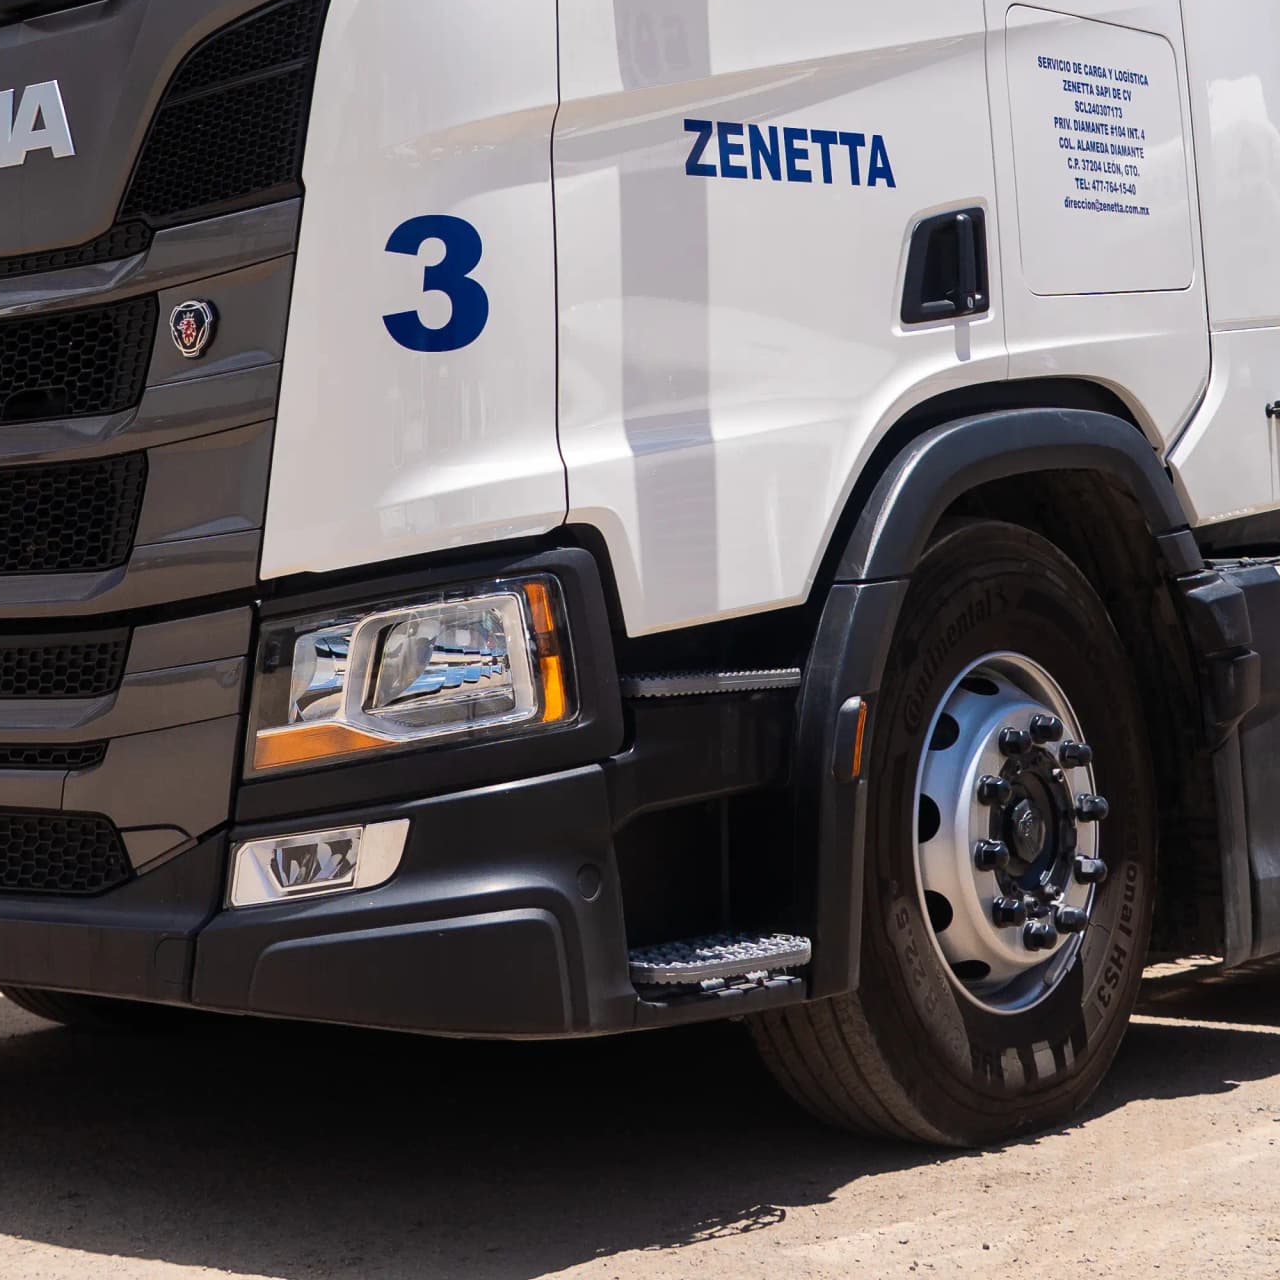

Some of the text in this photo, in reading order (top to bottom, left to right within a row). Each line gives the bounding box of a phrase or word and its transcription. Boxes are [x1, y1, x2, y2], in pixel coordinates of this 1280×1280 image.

[1037, 55, 1071, 73] SERVICIO
[1072, 62, 1082, 75] DE
[1083, 64, 1107, 79] CARGA
[1108, 68, 1113, 80] Y
[1062, 79, 1132, 102] ZENETTA SAPI DE CV
[1054, 116, 1072, 131] PRIV.
[1073, 119, 1109, 136] DIAMANTE
[1127, 127, 1140, 140] INT.
[1141, 129, 1145, 140] 4
[683, 118, 896, 188] ZENETTA
[1059, 137, 1144, 159] COL. ALAMEDA DIAMANTE
[1124, 164, 1140, 177] GTO.
[1075, 177, 1090, 191] TEL:
[381, 214, 489, 353] 3
